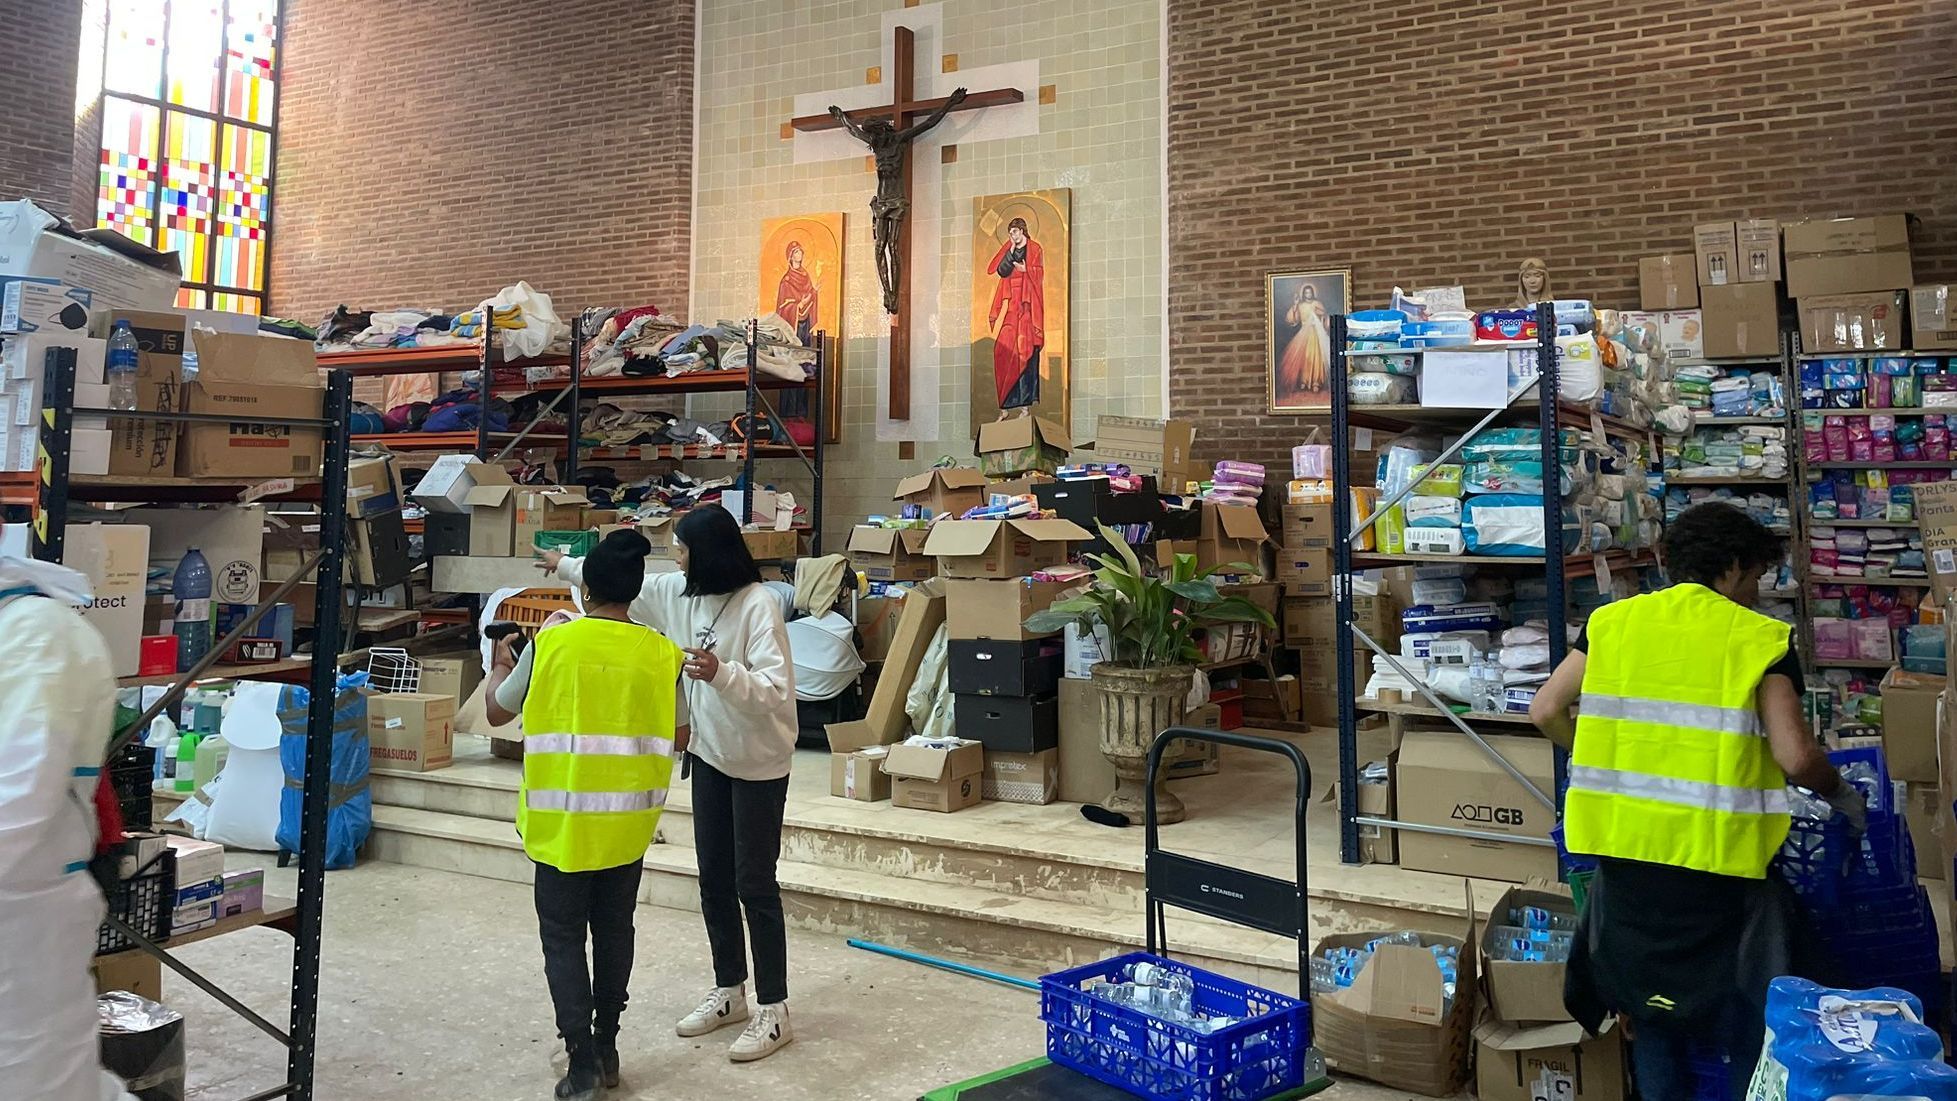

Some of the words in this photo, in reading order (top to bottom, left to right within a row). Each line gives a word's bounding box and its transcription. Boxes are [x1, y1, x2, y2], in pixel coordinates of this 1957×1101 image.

[370, 746, 417, 762] FREGASUELOS
[1494, 807, 1524, 826] GB
[1211, 886, 1244, 900] STANDERS
